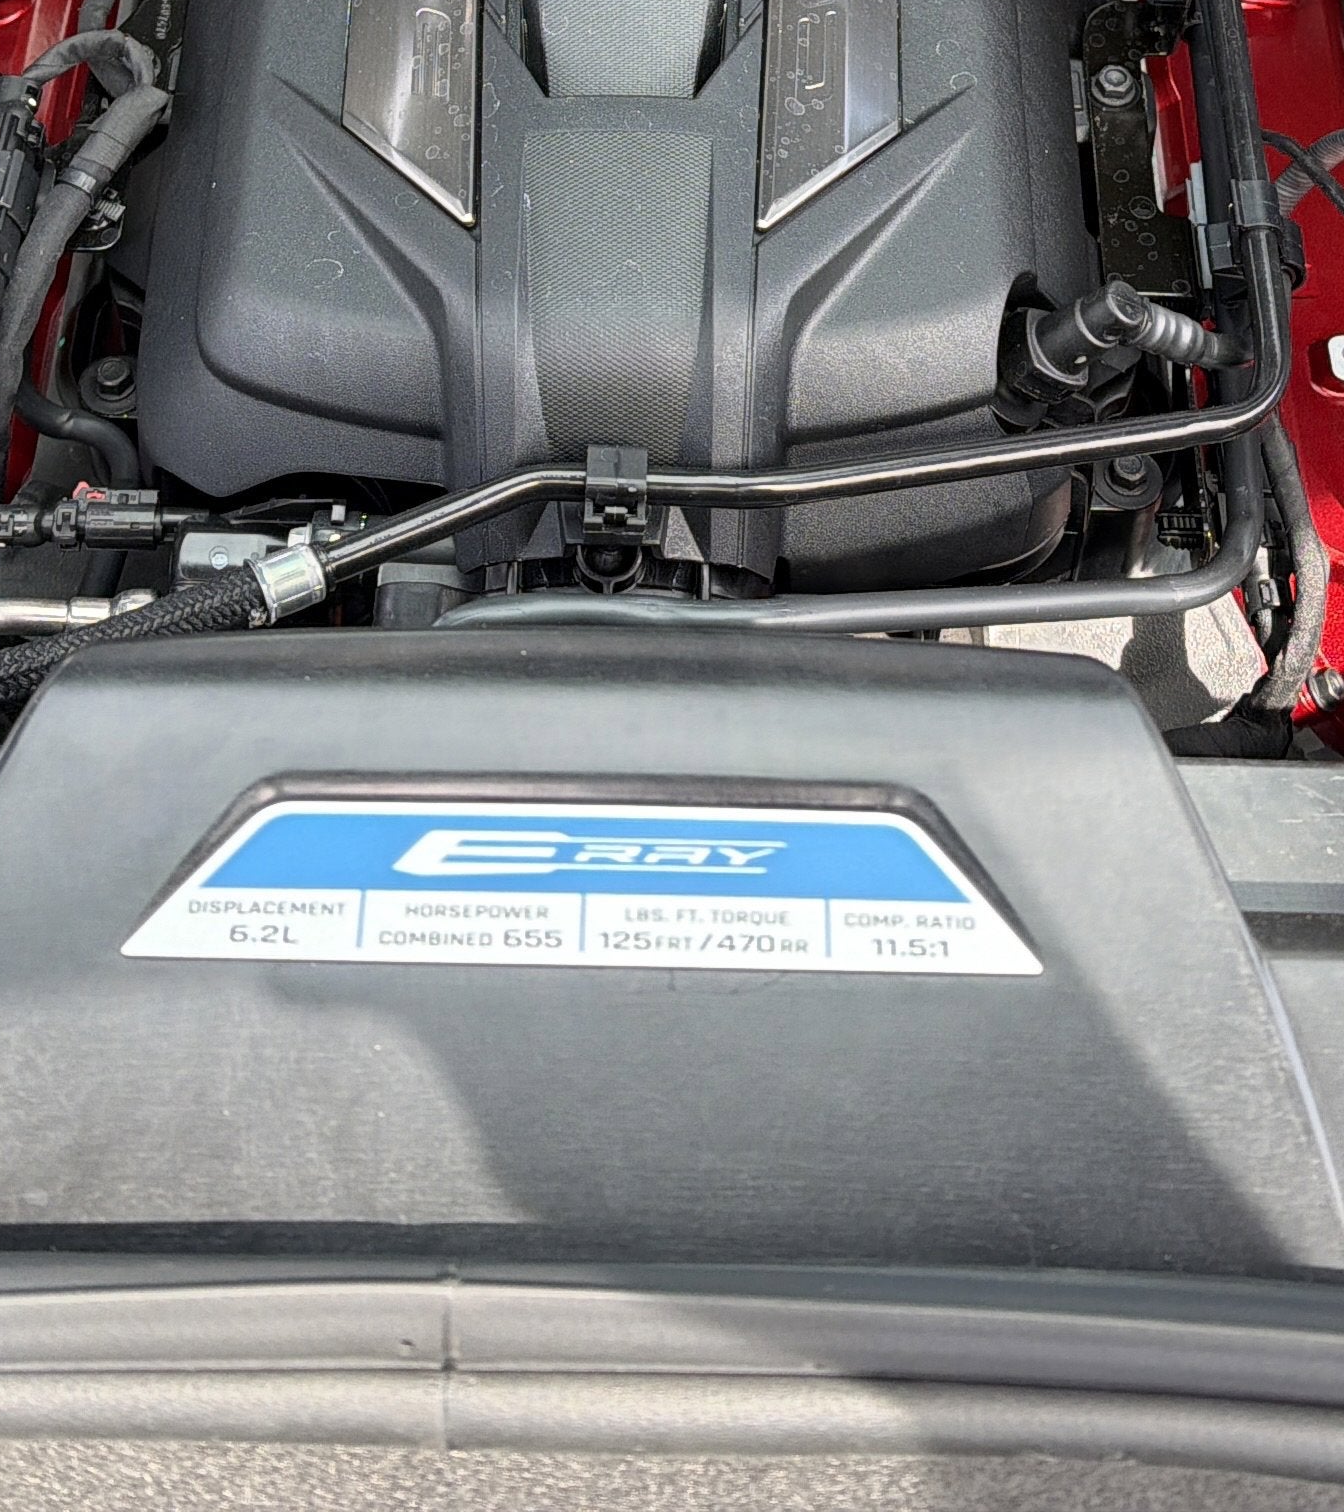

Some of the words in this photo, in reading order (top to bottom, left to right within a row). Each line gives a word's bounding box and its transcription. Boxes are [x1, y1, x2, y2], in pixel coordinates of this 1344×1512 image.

[187, 899, 346, 916] DISPLACEMENT
[404, 902, 549, 919] HORSEPOWER
[711, 909, 791, 927] TORQUE
[843, 912, 911, 929] COMP.
[916, 915, 977, 931] RATIO
[229, 925, 298, 944] 6.2L
[378, 930, 493, 947] COMBINED
[503, 929, 563, 948] 655
[873, 939, 950, 958] 11.5:1
